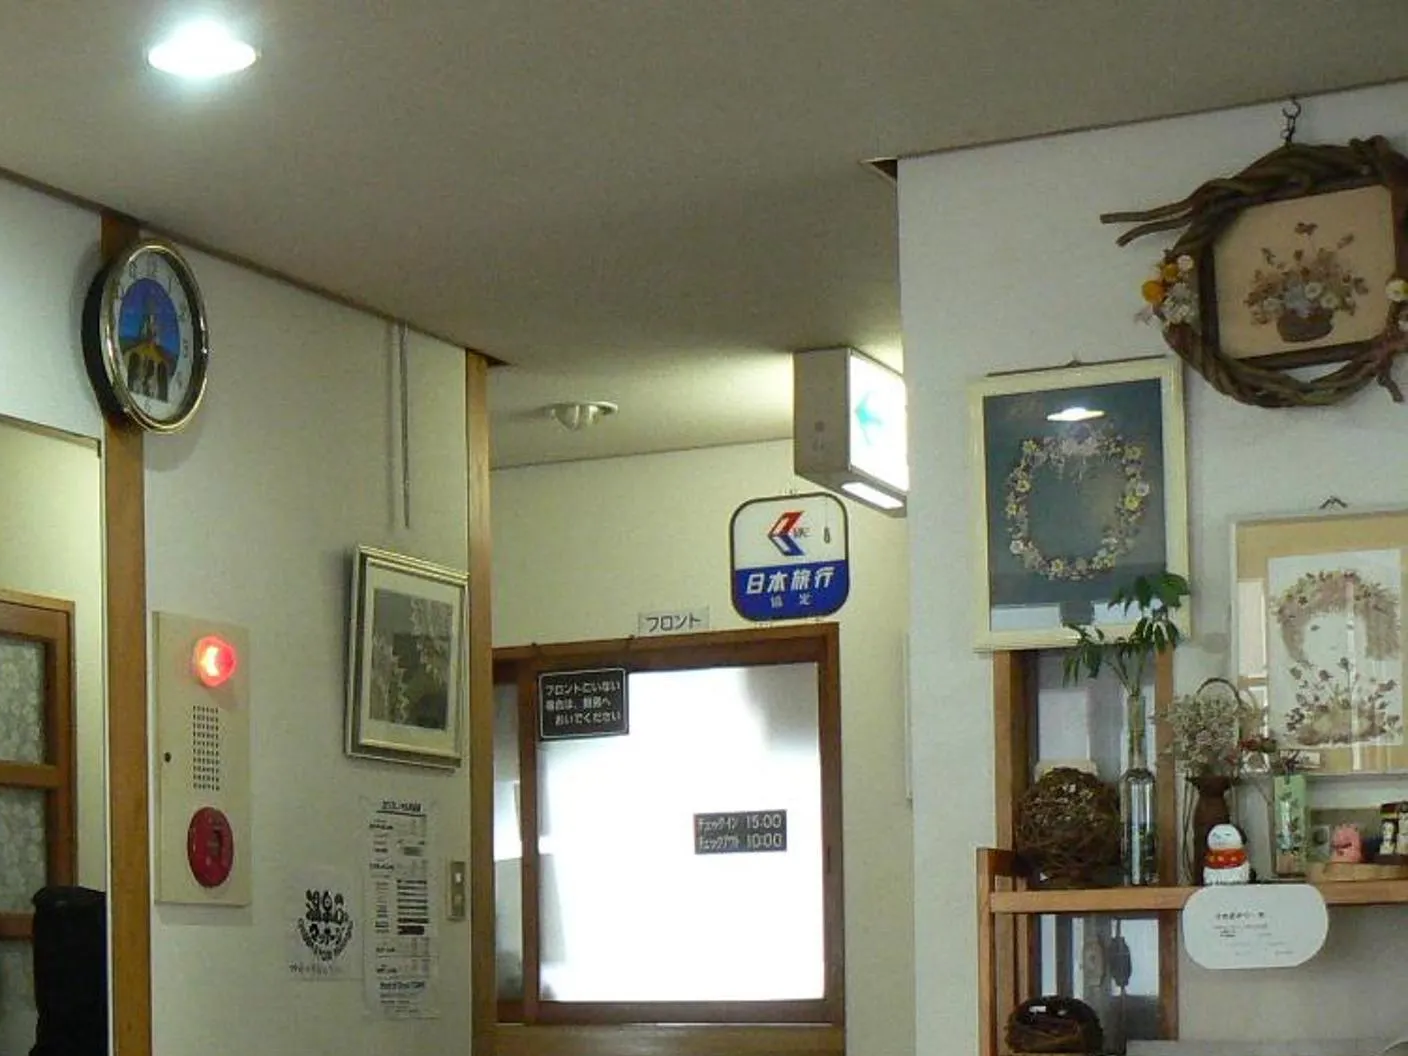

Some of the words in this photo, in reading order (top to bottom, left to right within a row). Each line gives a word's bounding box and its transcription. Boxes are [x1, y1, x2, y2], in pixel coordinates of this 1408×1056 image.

[745, 565, 836, 595] 日本旅行
[645, 611, 702, 633] フロント
[746, 813, 783, 829] 15:00
[746, 832, 783, 848] 10:00
